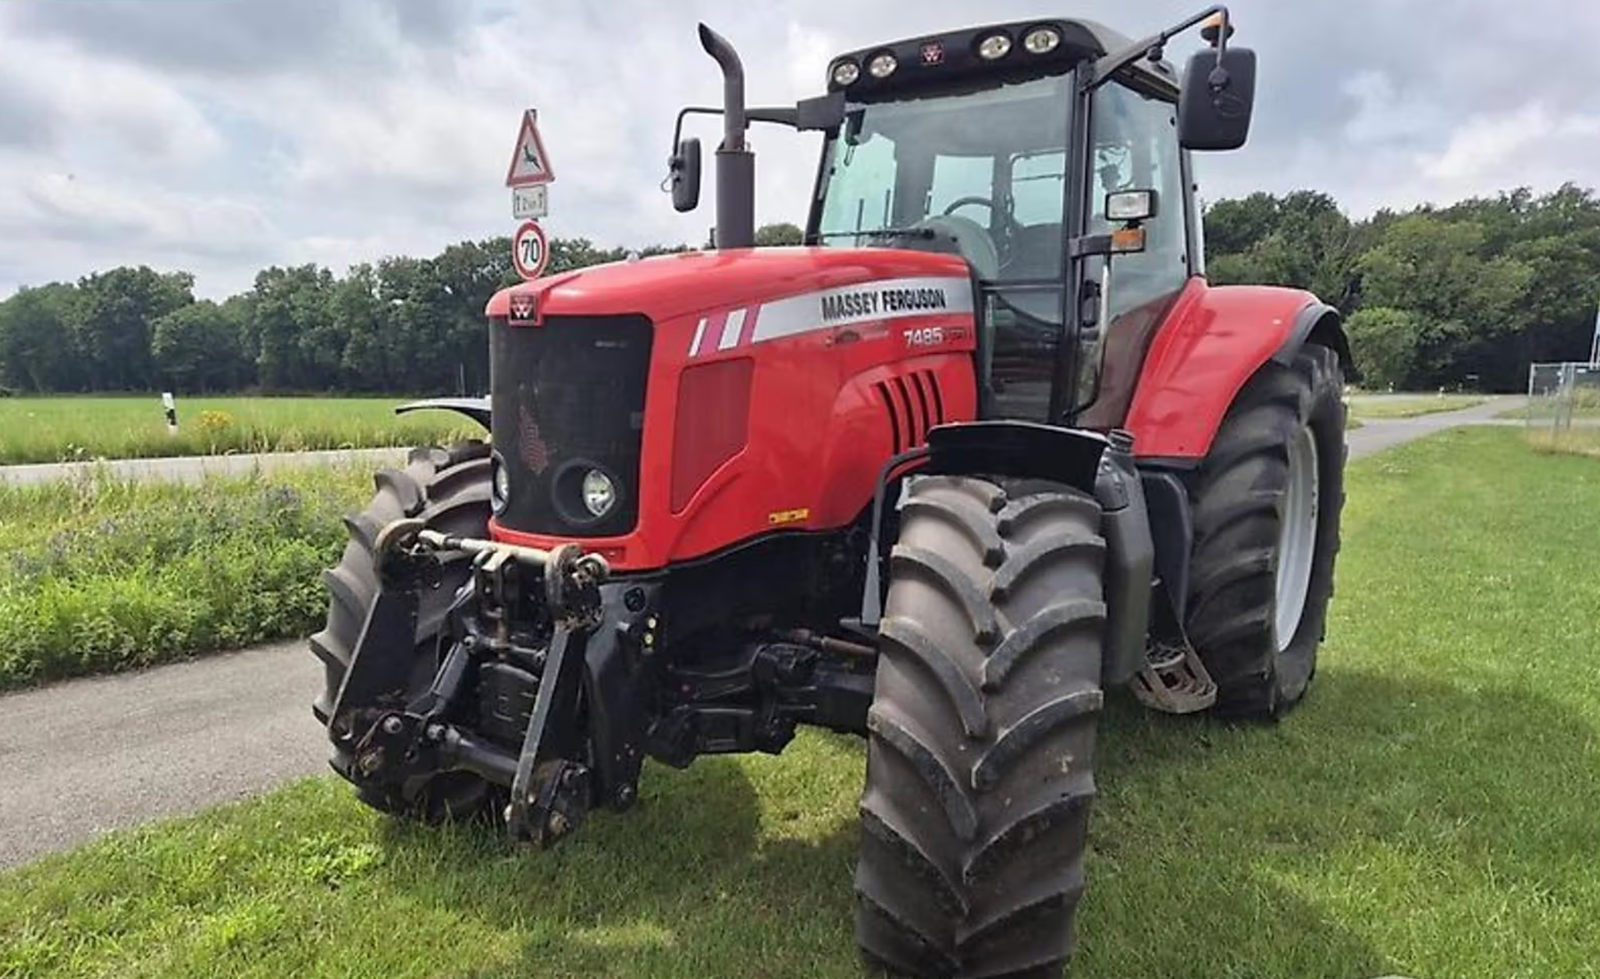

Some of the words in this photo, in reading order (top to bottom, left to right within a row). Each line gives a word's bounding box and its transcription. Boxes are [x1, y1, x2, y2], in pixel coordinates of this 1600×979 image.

[521, 238, 540, 264] 70
[821, 290, 879, 321] MASSEY
[881, 289, 947, 313] FERGUSON
